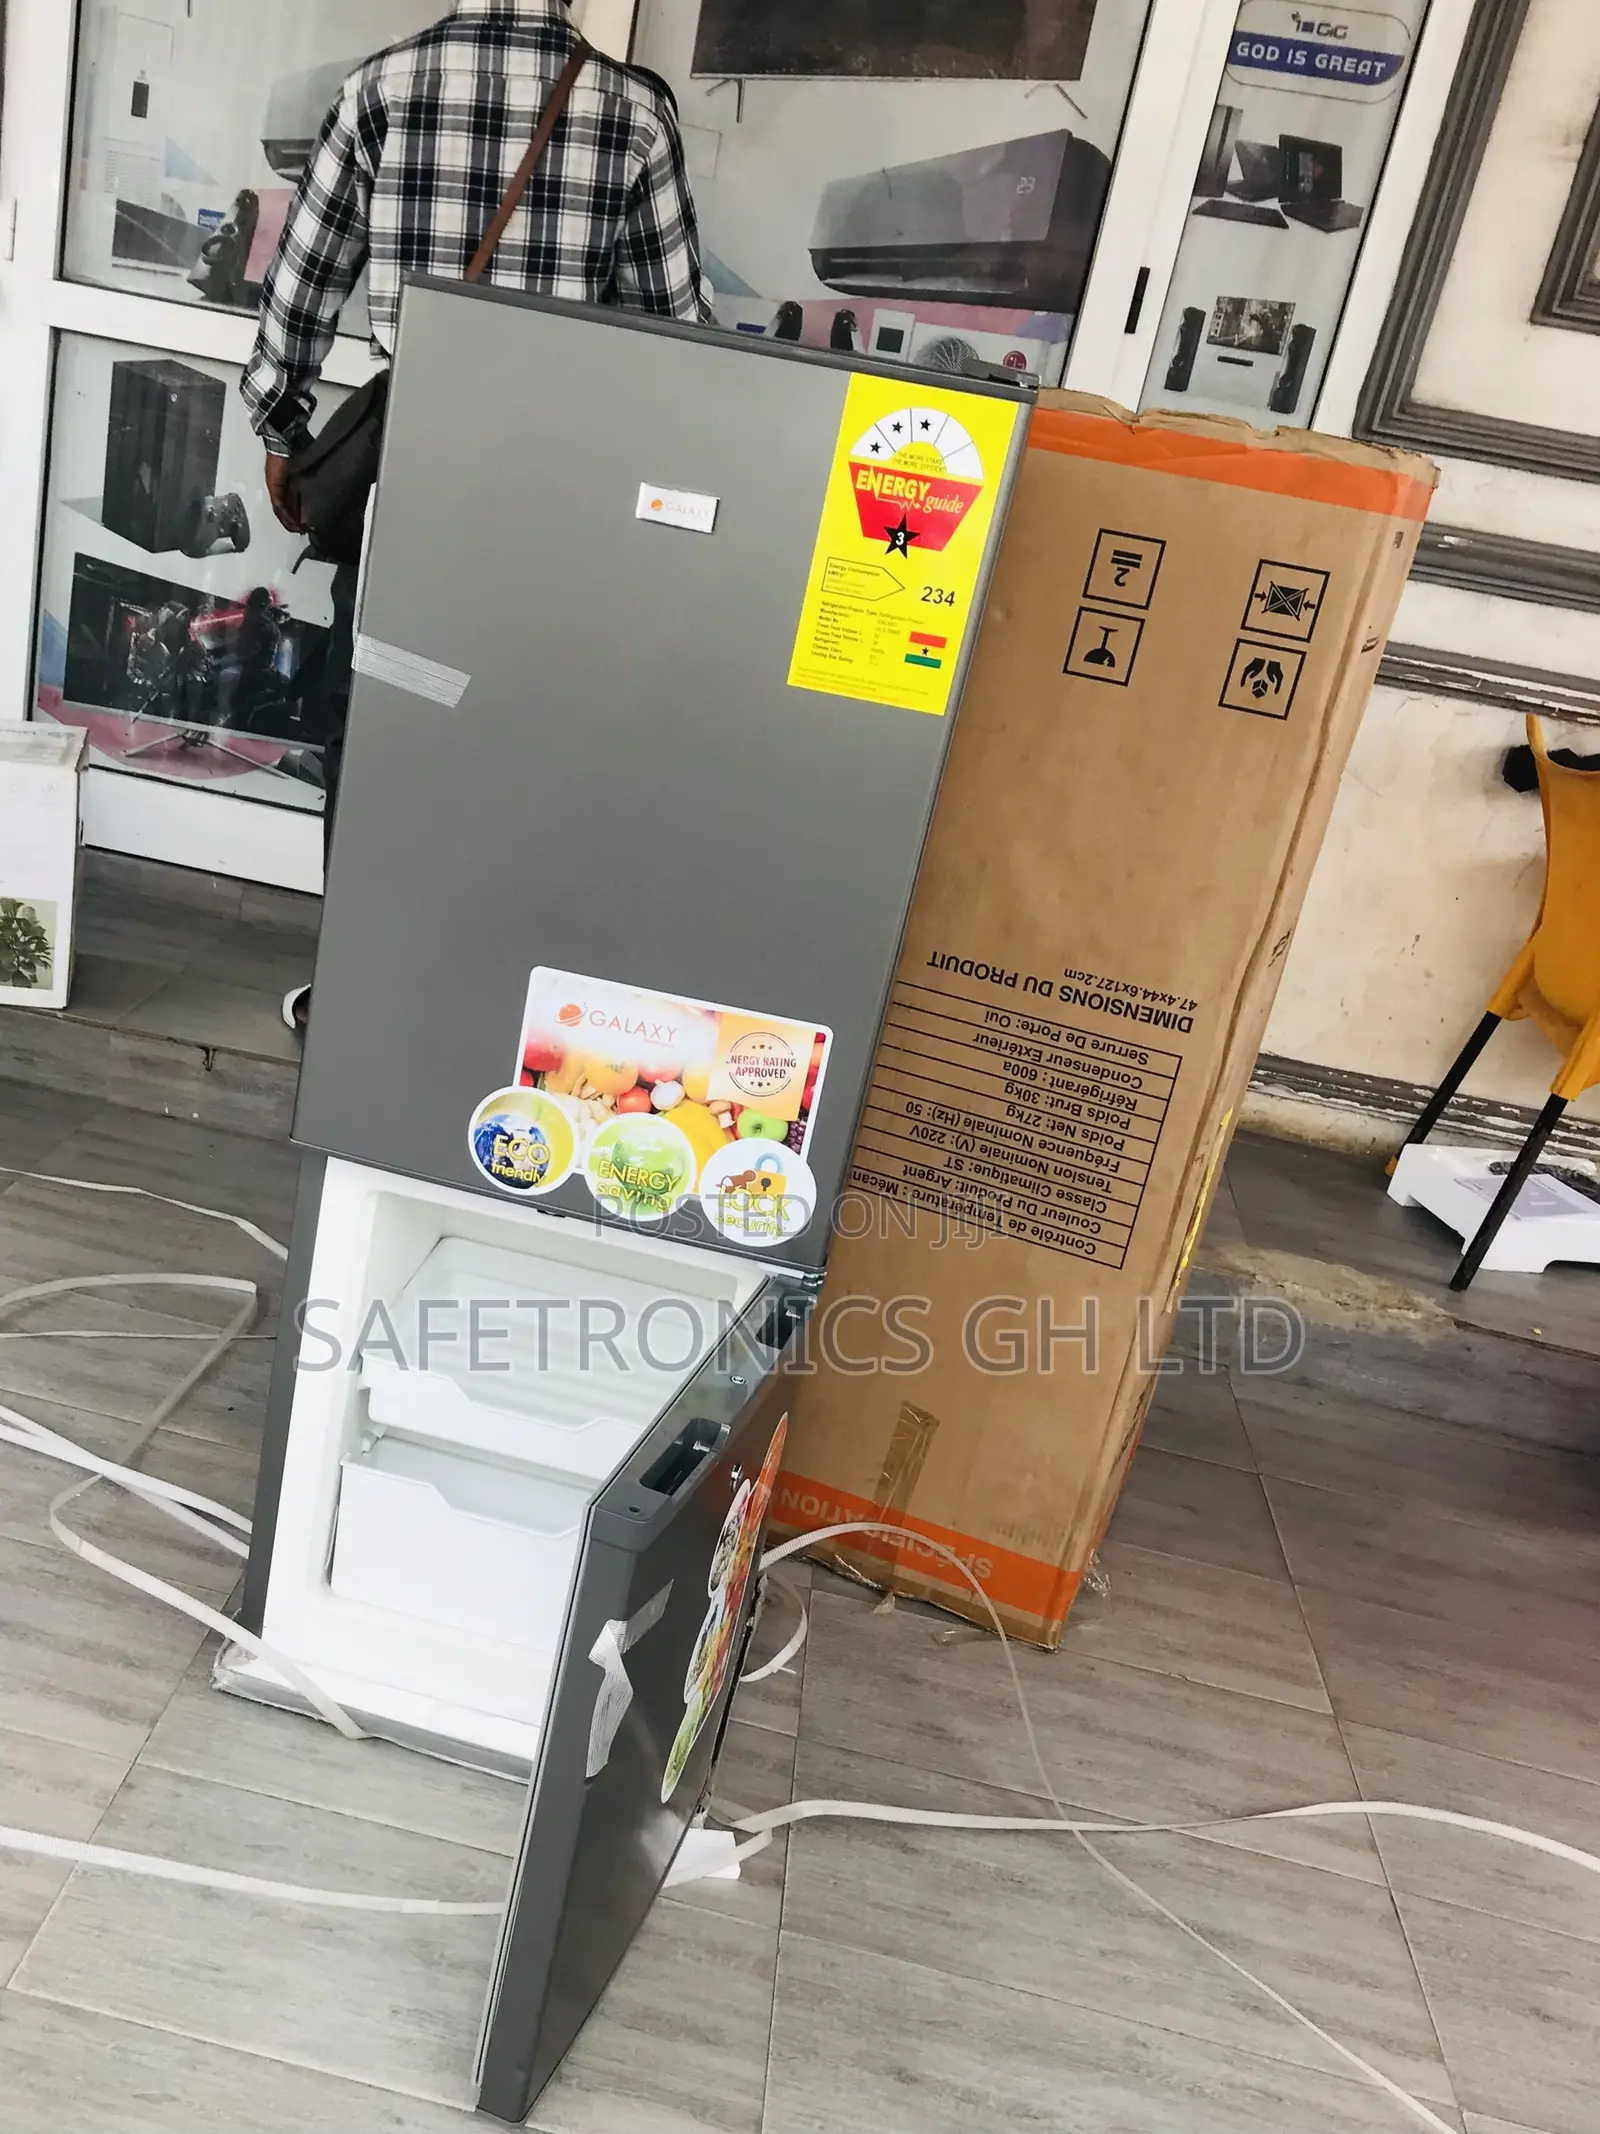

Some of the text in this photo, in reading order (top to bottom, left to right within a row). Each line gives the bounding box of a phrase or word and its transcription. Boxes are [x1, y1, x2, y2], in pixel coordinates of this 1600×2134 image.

[1236, 42, 1386, 78] GOD IS GREAT
[855, 465, 931, 501] ENERGY
[923, 494, 964, 513] guide
[895, 532, 905, 545] 3
[1114, 566, 1130, 587] 2
[920, 586, 956, 606] 234
[926, 951, 1195, 1034] DIMENSIONS DU PRODUIT
[1063, 968, 1198, 1011] 47.4x44.6x127.2cm
[589, 1010, 679, 1042] GALAXY
[984, 1010, 1150, 1066] Serrure De Porte: Oui
[735, 1066, 786, 1079] APPROVED
[762, 1056, 797, 1068] RATING
[972, 1032, 1143, 1090] Condenseur Extérieur
[1003, 1060, 1038, 1081] 600a
[1004, 1081, 1132, 1131] Poids Brut: 30kg
[905, 1101, 1120, 1173] Fréquence Nominale (Hz): 50
[1005, 1104, 1126, 1152] Poids Net: 27kg
[493, 1134, 551, 1165] ECO
[909, 1124, 1112, 1194] Tension Nominale (V): 220V
[491, 1161, 547, 1187] friendly
[597, 1159, 680, 1192] ENERGY
[943, 1156, 1107, 1213] Classe Climatique: ST
[597, 1180, 672, 1212] saving
[718, 1184, 792, 1221] LOCK
[903, 1164, 1101, 1234] Couleur Du Produit: Argent
[714, 1211, 786, 1239] security
[1008, 1219, 1027, 1233] de
[1031, 1226, 1096, 1255] Contrôle
